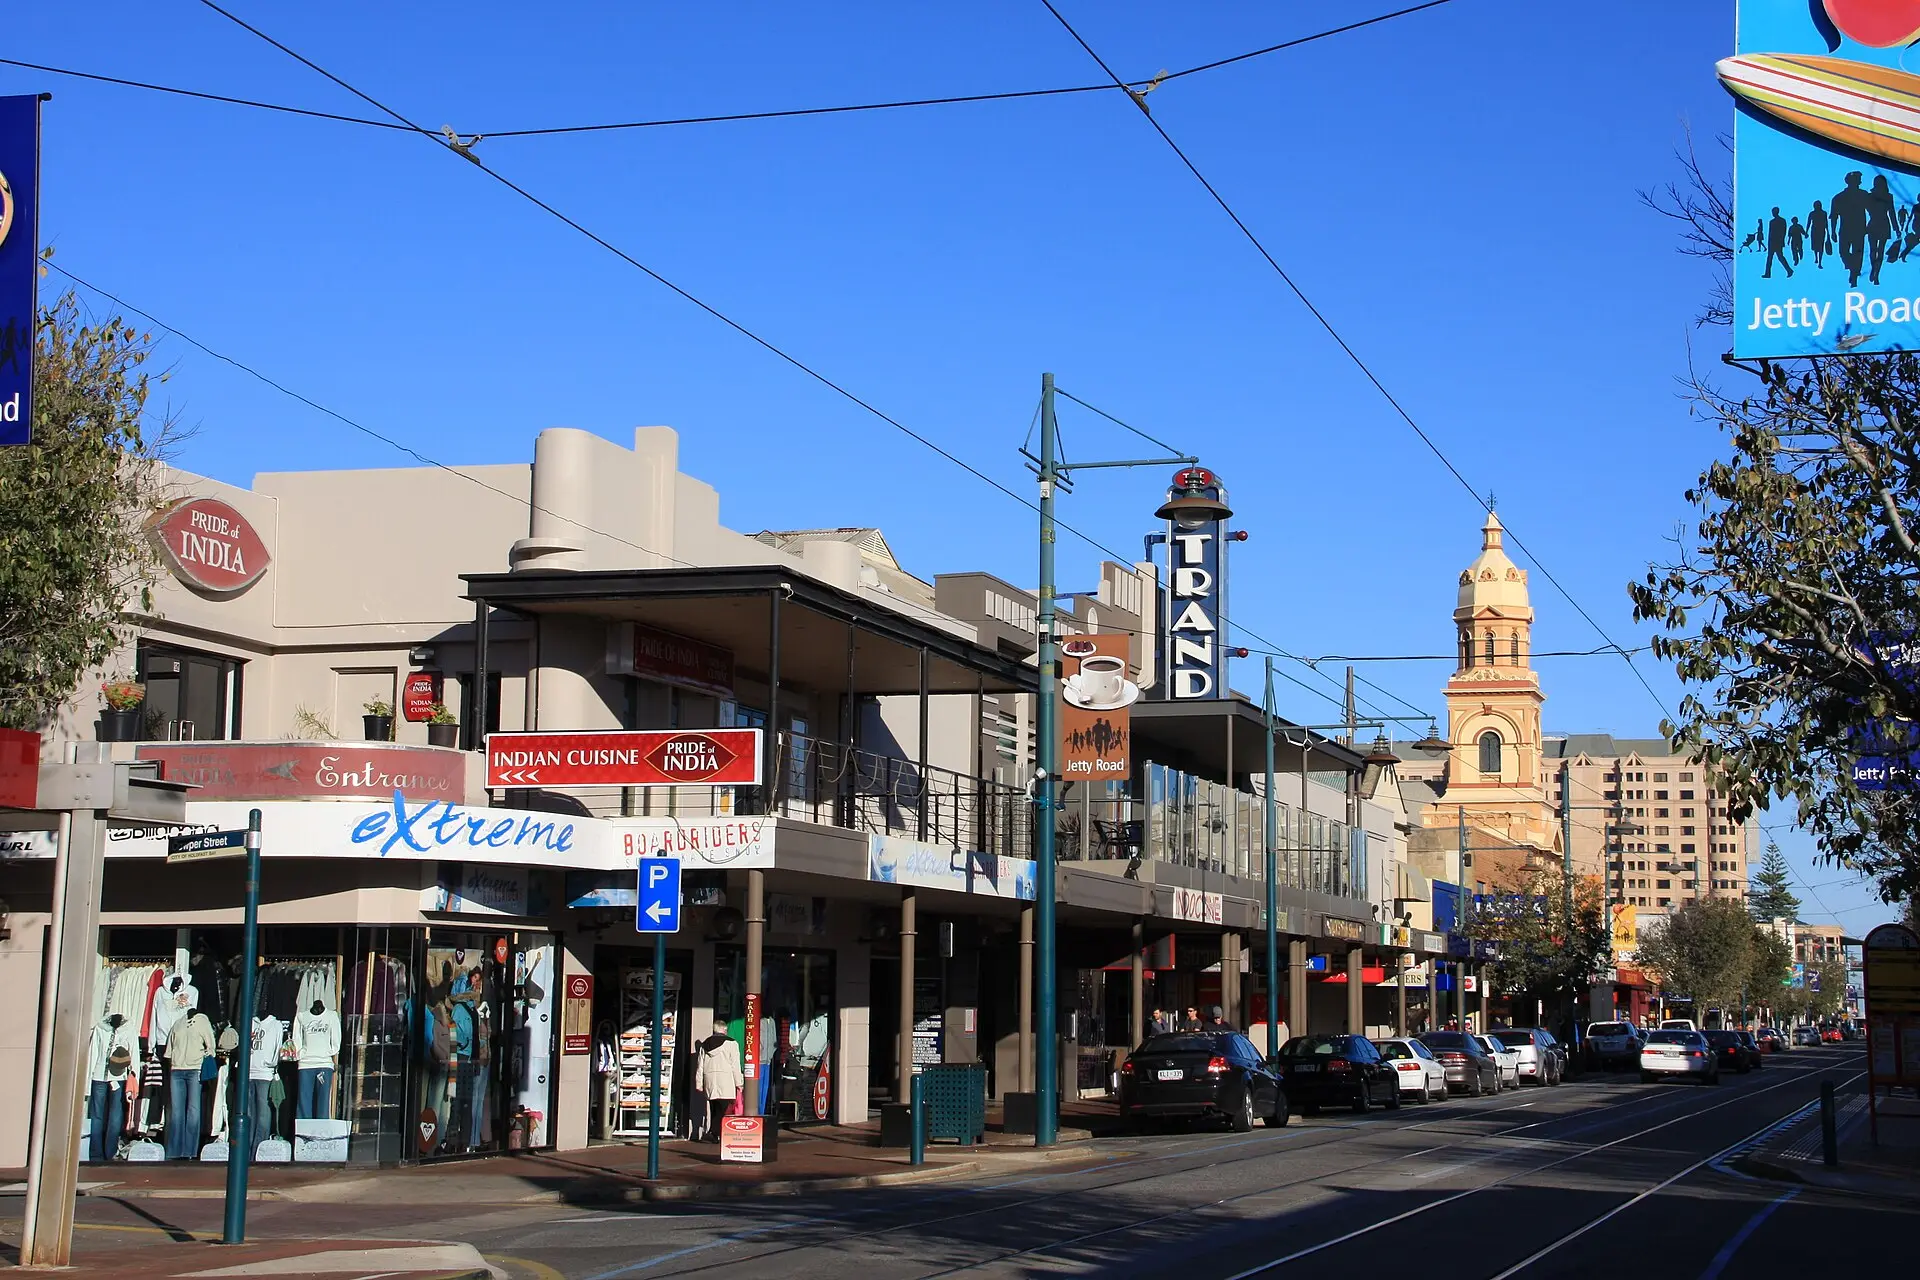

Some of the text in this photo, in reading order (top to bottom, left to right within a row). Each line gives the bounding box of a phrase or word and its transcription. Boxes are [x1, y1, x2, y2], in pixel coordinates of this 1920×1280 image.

[1747, 297, 1832, 337] Jetty
[190, 510, 241, 539] PRIDE of
[180, 530, 248, 576] INDIA
[494, 749, 639, 768] INDIAN CUISINE
[666, 741, 716, 755] PRIDE of
[315, 755, 450, 791] Entrance
[663, 754, 719, 771] INDIA
[1066, 757, 1125, 775] Jetty Road
[203, 836, 228, 848] Street
[624, 821, 762, 856] BOARDRIDERS
[649, 866, 669, 889] P
[746, 1031, 754, 1053] INDIA
